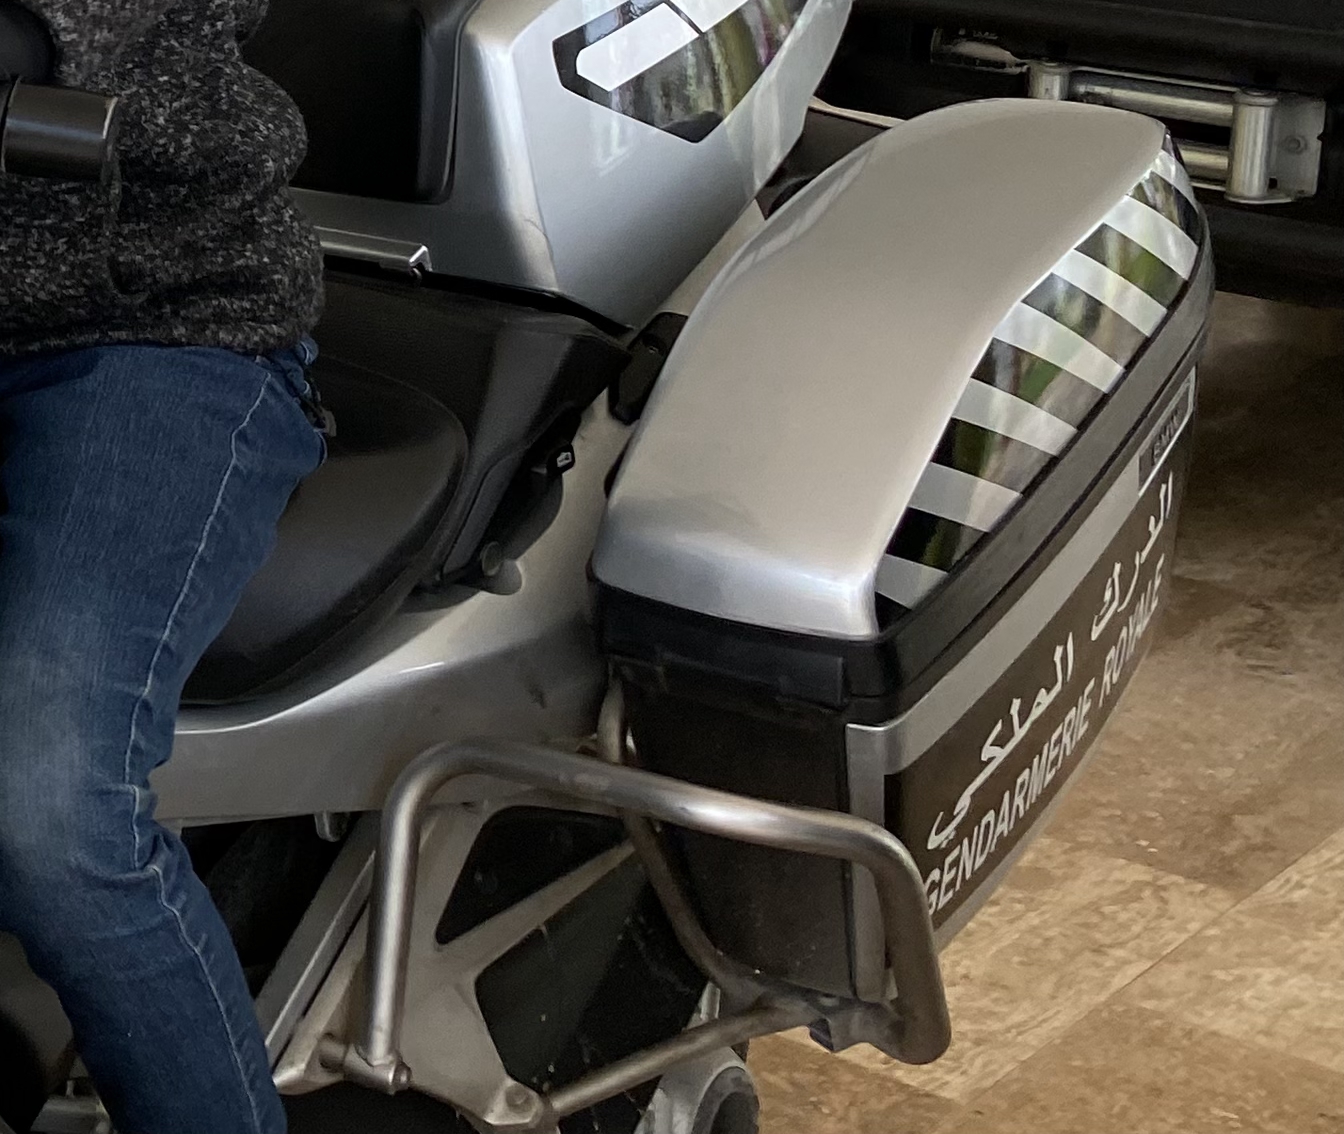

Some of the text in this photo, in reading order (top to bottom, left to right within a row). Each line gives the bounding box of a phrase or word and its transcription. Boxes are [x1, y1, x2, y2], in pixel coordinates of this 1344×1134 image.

[924, 553, 1165, 916] GENDARMERIE ROYALE
[927, 470, 1173, 851] الدرك الملكي
